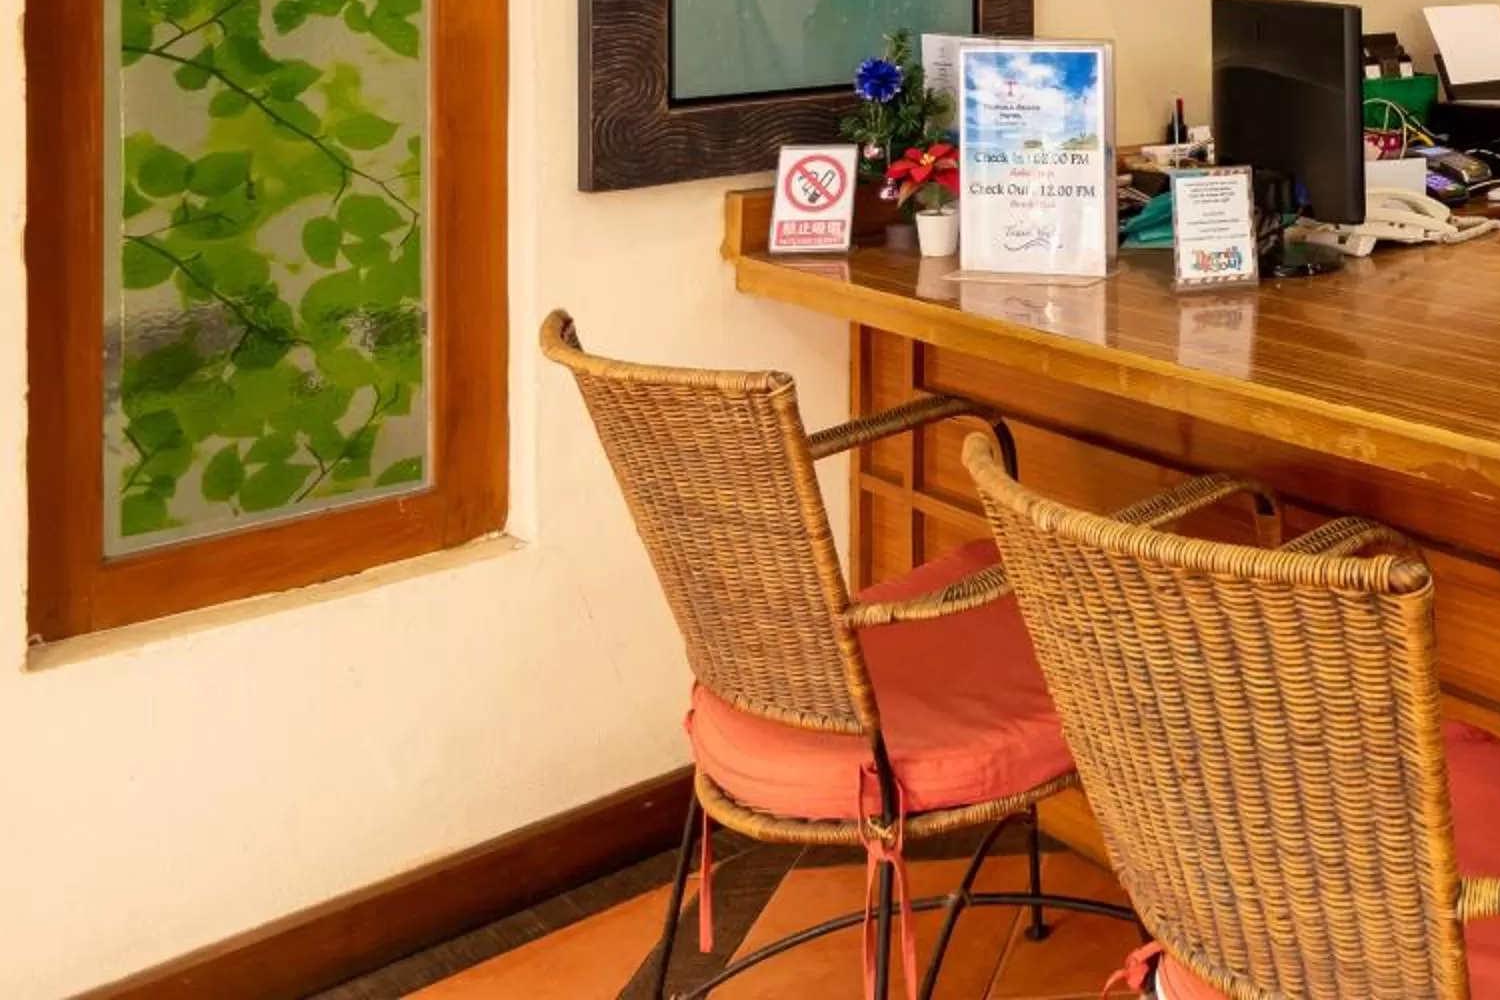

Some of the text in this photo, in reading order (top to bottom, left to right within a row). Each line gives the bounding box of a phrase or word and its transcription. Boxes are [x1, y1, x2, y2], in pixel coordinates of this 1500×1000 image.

[974, 151, 1008, 163] Check
[1071, 154, 1089, 165] PM
[969, 183, 1004, 195] Check
[1076, 186, 1096, 197] PM
